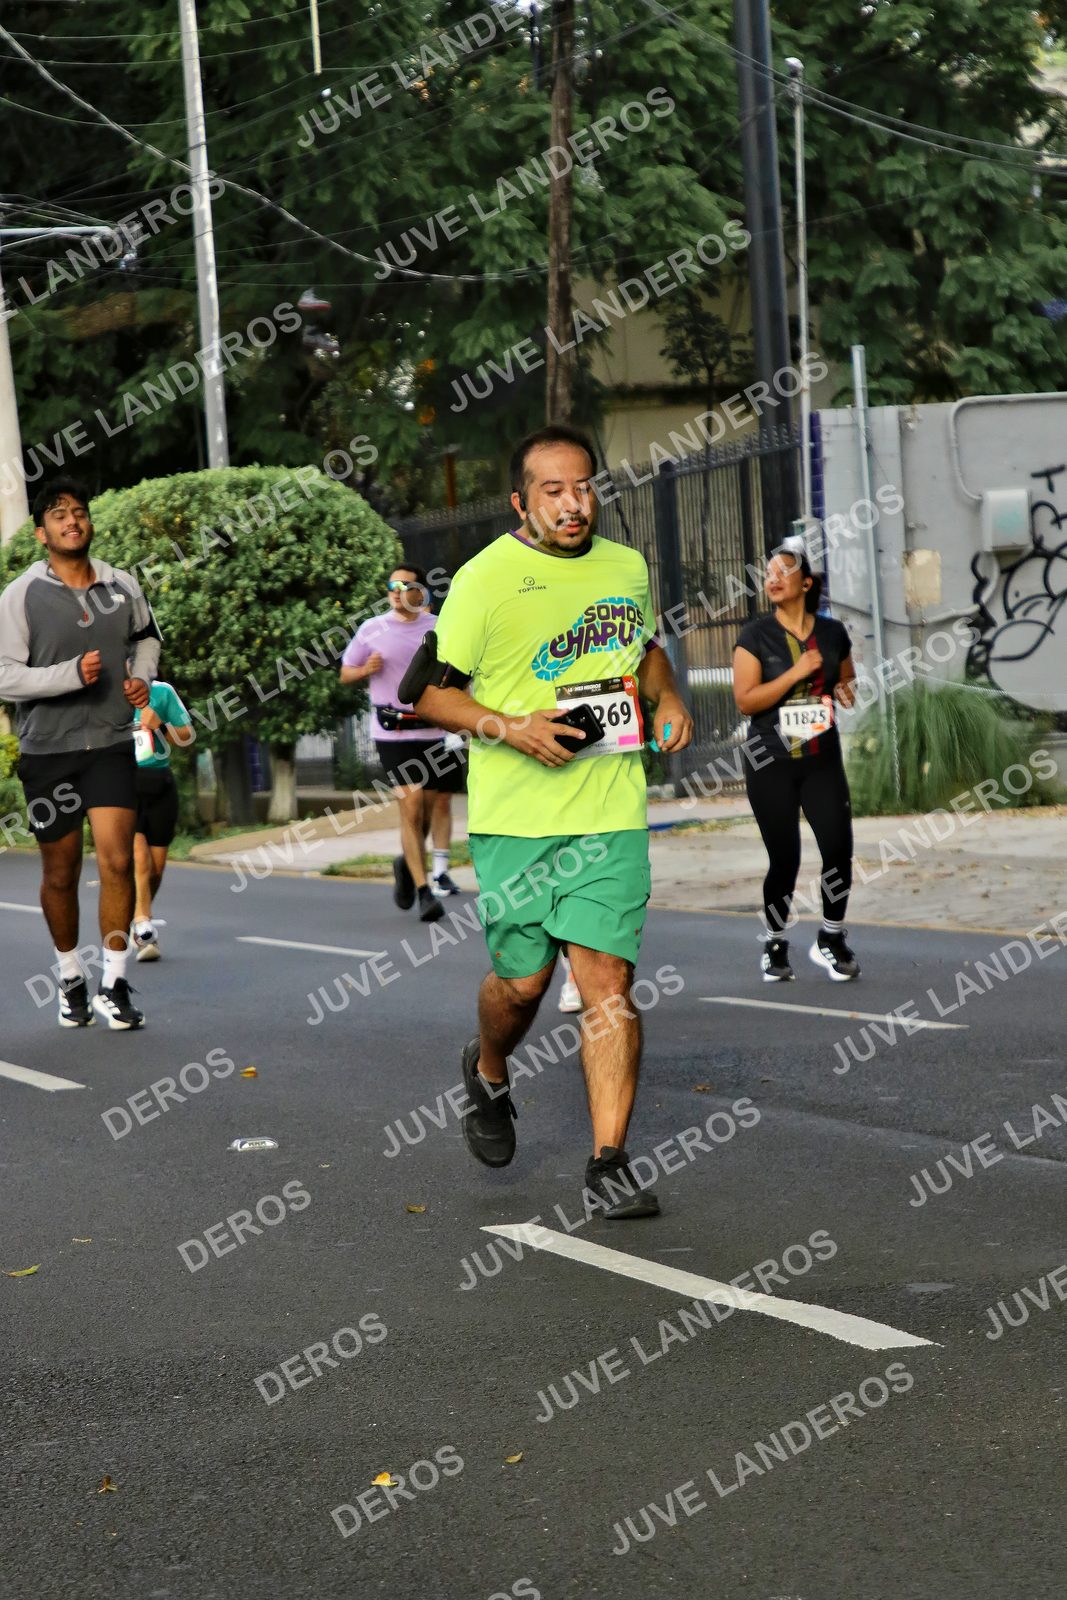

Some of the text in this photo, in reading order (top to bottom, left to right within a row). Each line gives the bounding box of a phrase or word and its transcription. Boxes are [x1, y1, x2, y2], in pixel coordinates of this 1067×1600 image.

[518, 585, 547, 594] TOPTIME
[583, 604, 644, 627] SOMOS
[549, 621, 635, 660] CHAPU
[784, 709, 826, 726] 11825
